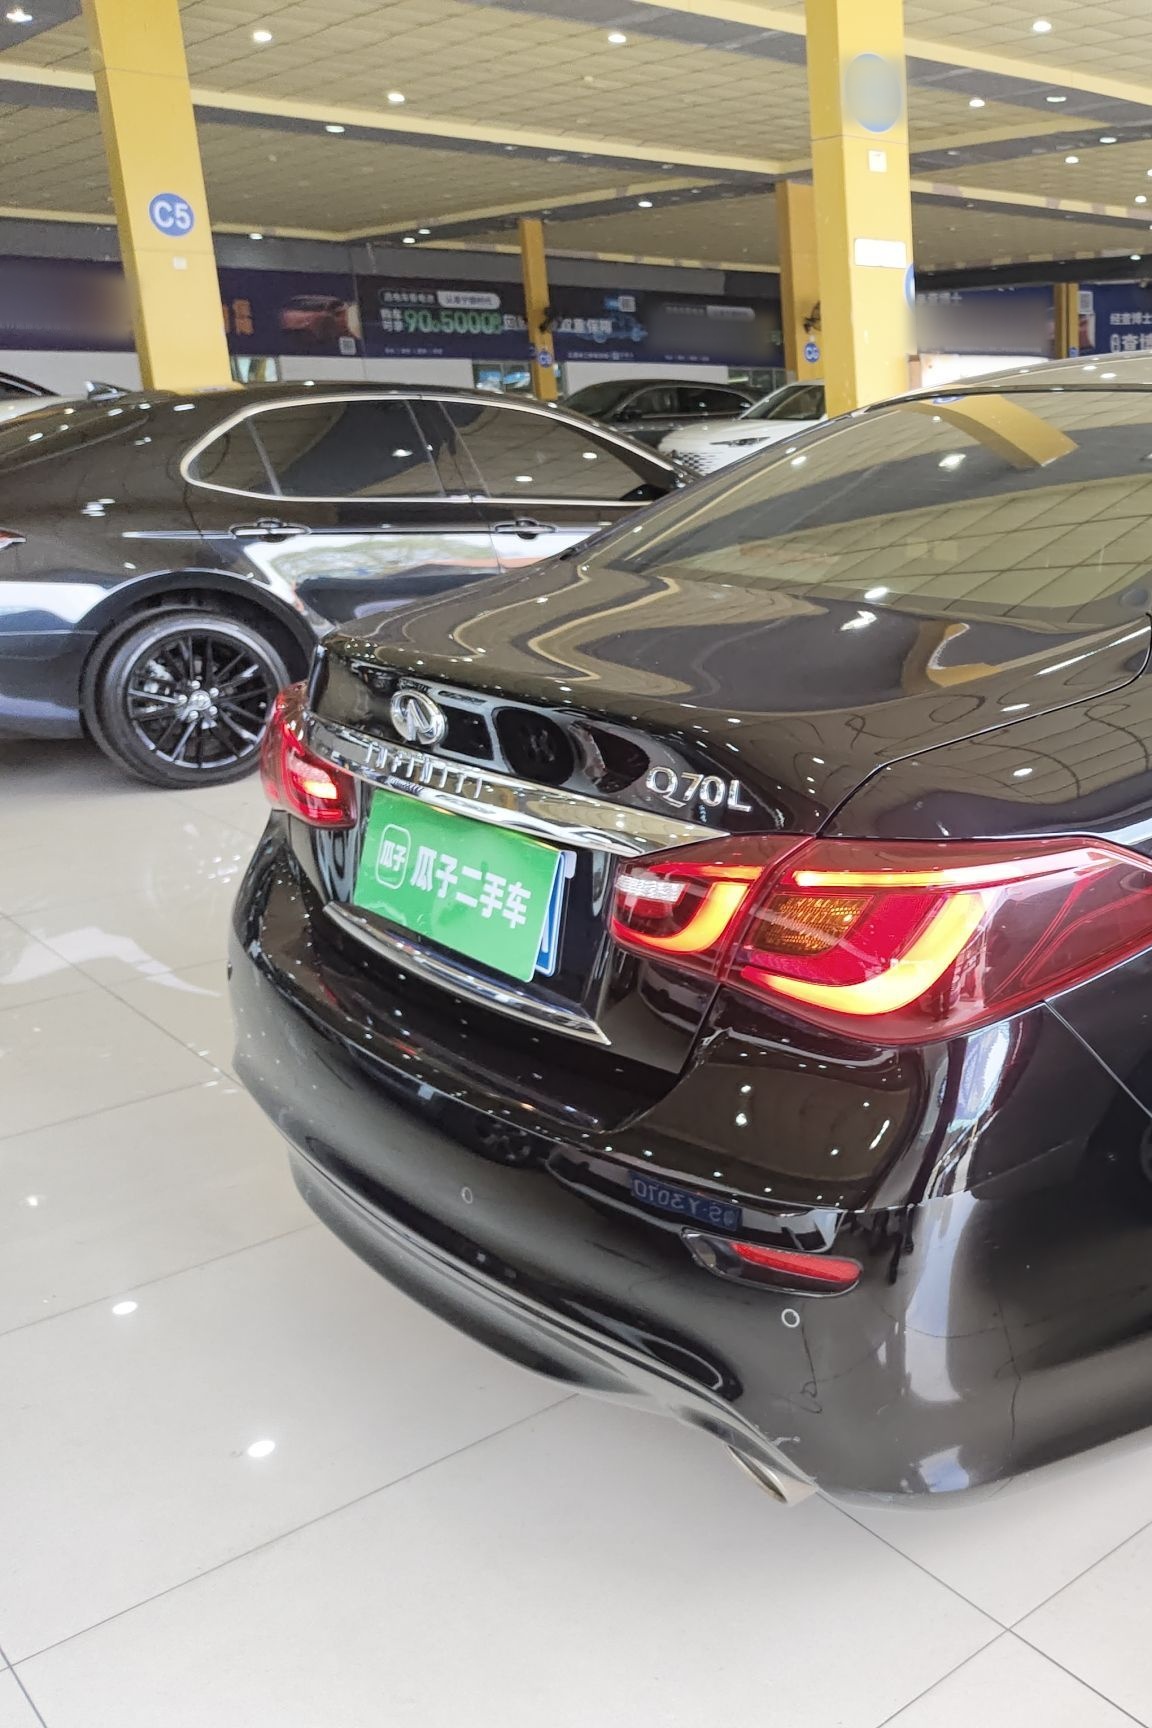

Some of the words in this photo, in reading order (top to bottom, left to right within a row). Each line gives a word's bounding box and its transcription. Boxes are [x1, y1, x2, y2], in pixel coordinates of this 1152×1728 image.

[154, 200, 192, 231] C5
[645, 766, 753, 812] Q70L
[379, 840, 407, 872] 瓜子
[410, 845, 532, 929] 瓜子二手车
